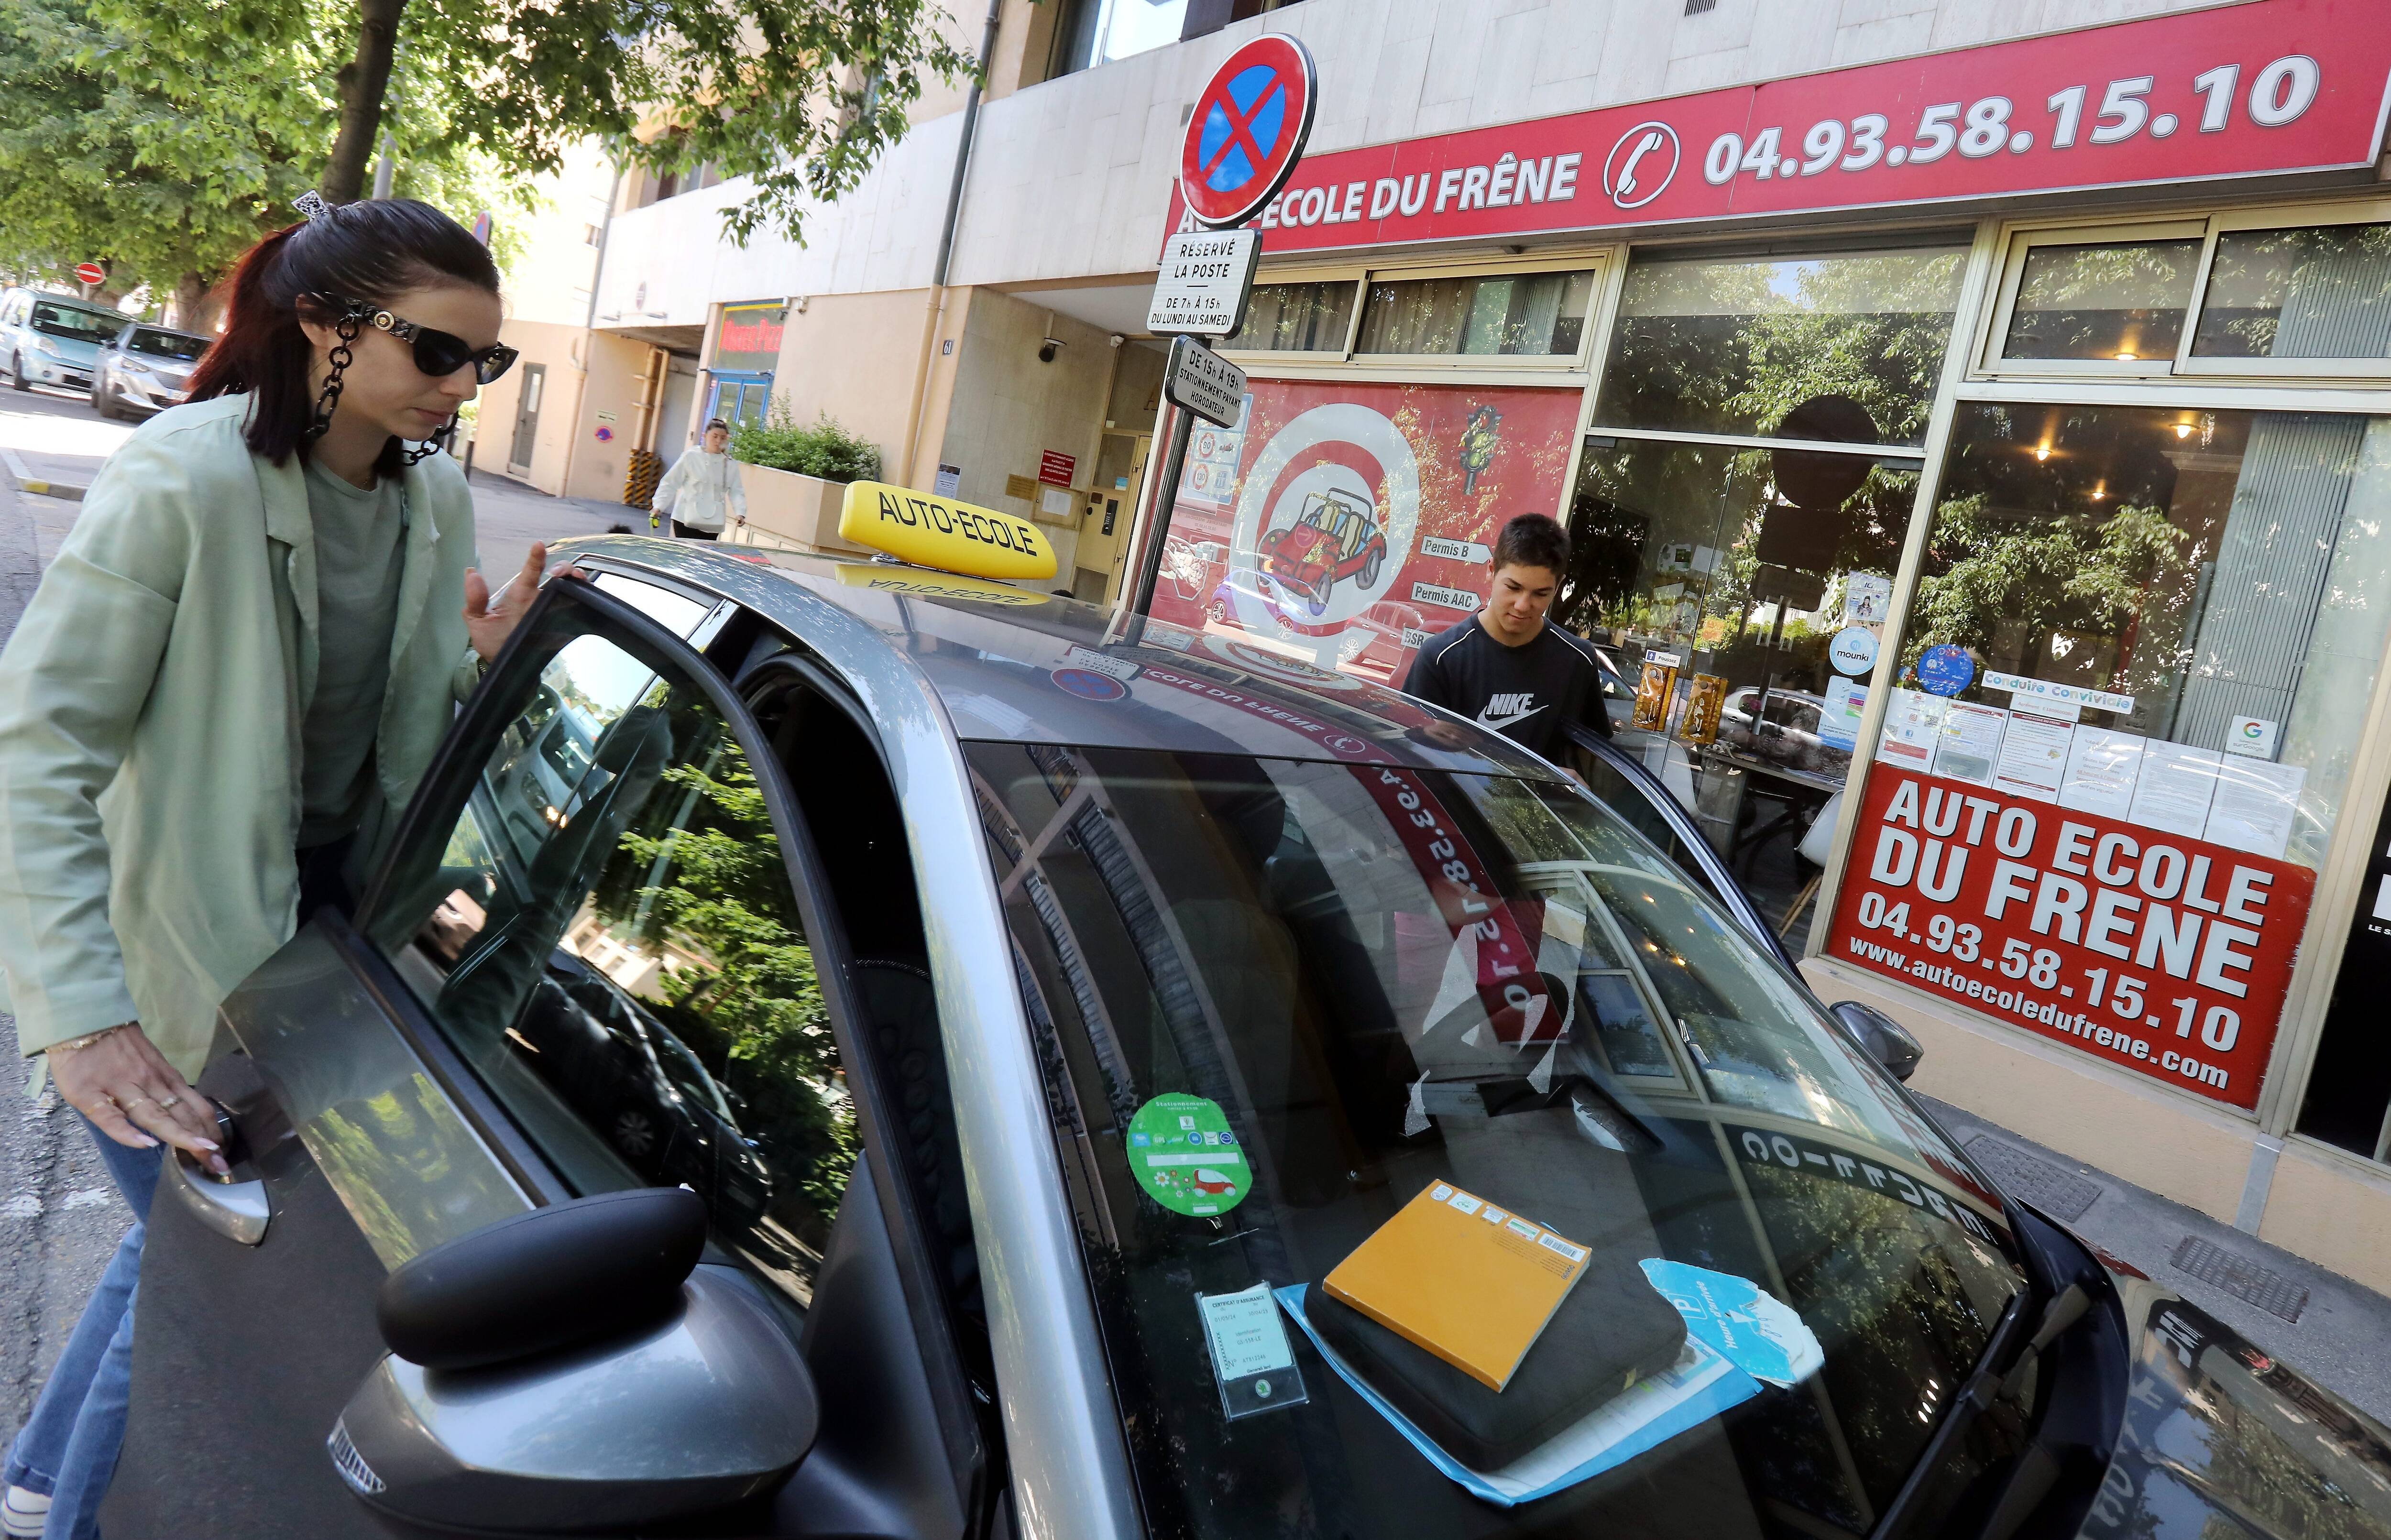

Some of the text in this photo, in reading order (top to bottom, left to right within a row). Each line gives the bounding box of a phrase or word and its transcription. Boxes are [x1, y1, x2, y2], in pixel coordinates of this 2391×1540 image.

[1176, 54, 2320, 233] A-ECOLE DU FRÊNE 04.93.58.15.10
[1180, 238, 1235, 257] RÉSERVÉ
[1174, 263, 1230, 278] LA POSTE
[1166, 297, 1220, 309] DE 7h À 15h
[1151, 313, 1231, 326] DU LUNDI AU SAMEDI
[943, 341, 952, 354] 61
[1189, 350, 1239, 391] DE 15h À 19h
[1179, 367, 1240, 409] STATIONNEMENT PAYANT
[1190, 390, 1225, 416] HORODATEUR
[1203, 441, 1211, 450] 90
[1197, 472, 1205, 481] 130
[878, 491, 1038, 557] AUTO-ECOLE
[1424, 539, 1469, 557] Permis B
[1415, 585, 1472, 608] Permis AAC
[1404, 631, 1424, 646] BSR
[1658, 655, 1677, 664] Poussez
[1837, 650, 1869, 662] mounki
[1486, 693, 1534, 715] NIKE
[2243, 743, 2264, 752] Google
[1883, 779, 2038, 858] AUTO
[2051, 819, 2275, 927] ECOLE
[1869, 825, 2260, 999] DU FRENE
[2368, 924, 2382, 933] LE
[1858, 891, 2241, 1053] 04.93.58.15.10
[1849, 935, 2229, 1090] www.autoecoledufrene.com
[1212, 1300, 1235, 1308] CERTIFICAT
[1673, 1298, 1701, 1313] P
[1696, 1280, 1722, 1319] d'arrivée
[1717, 1319, 1738, 1350] Heure
